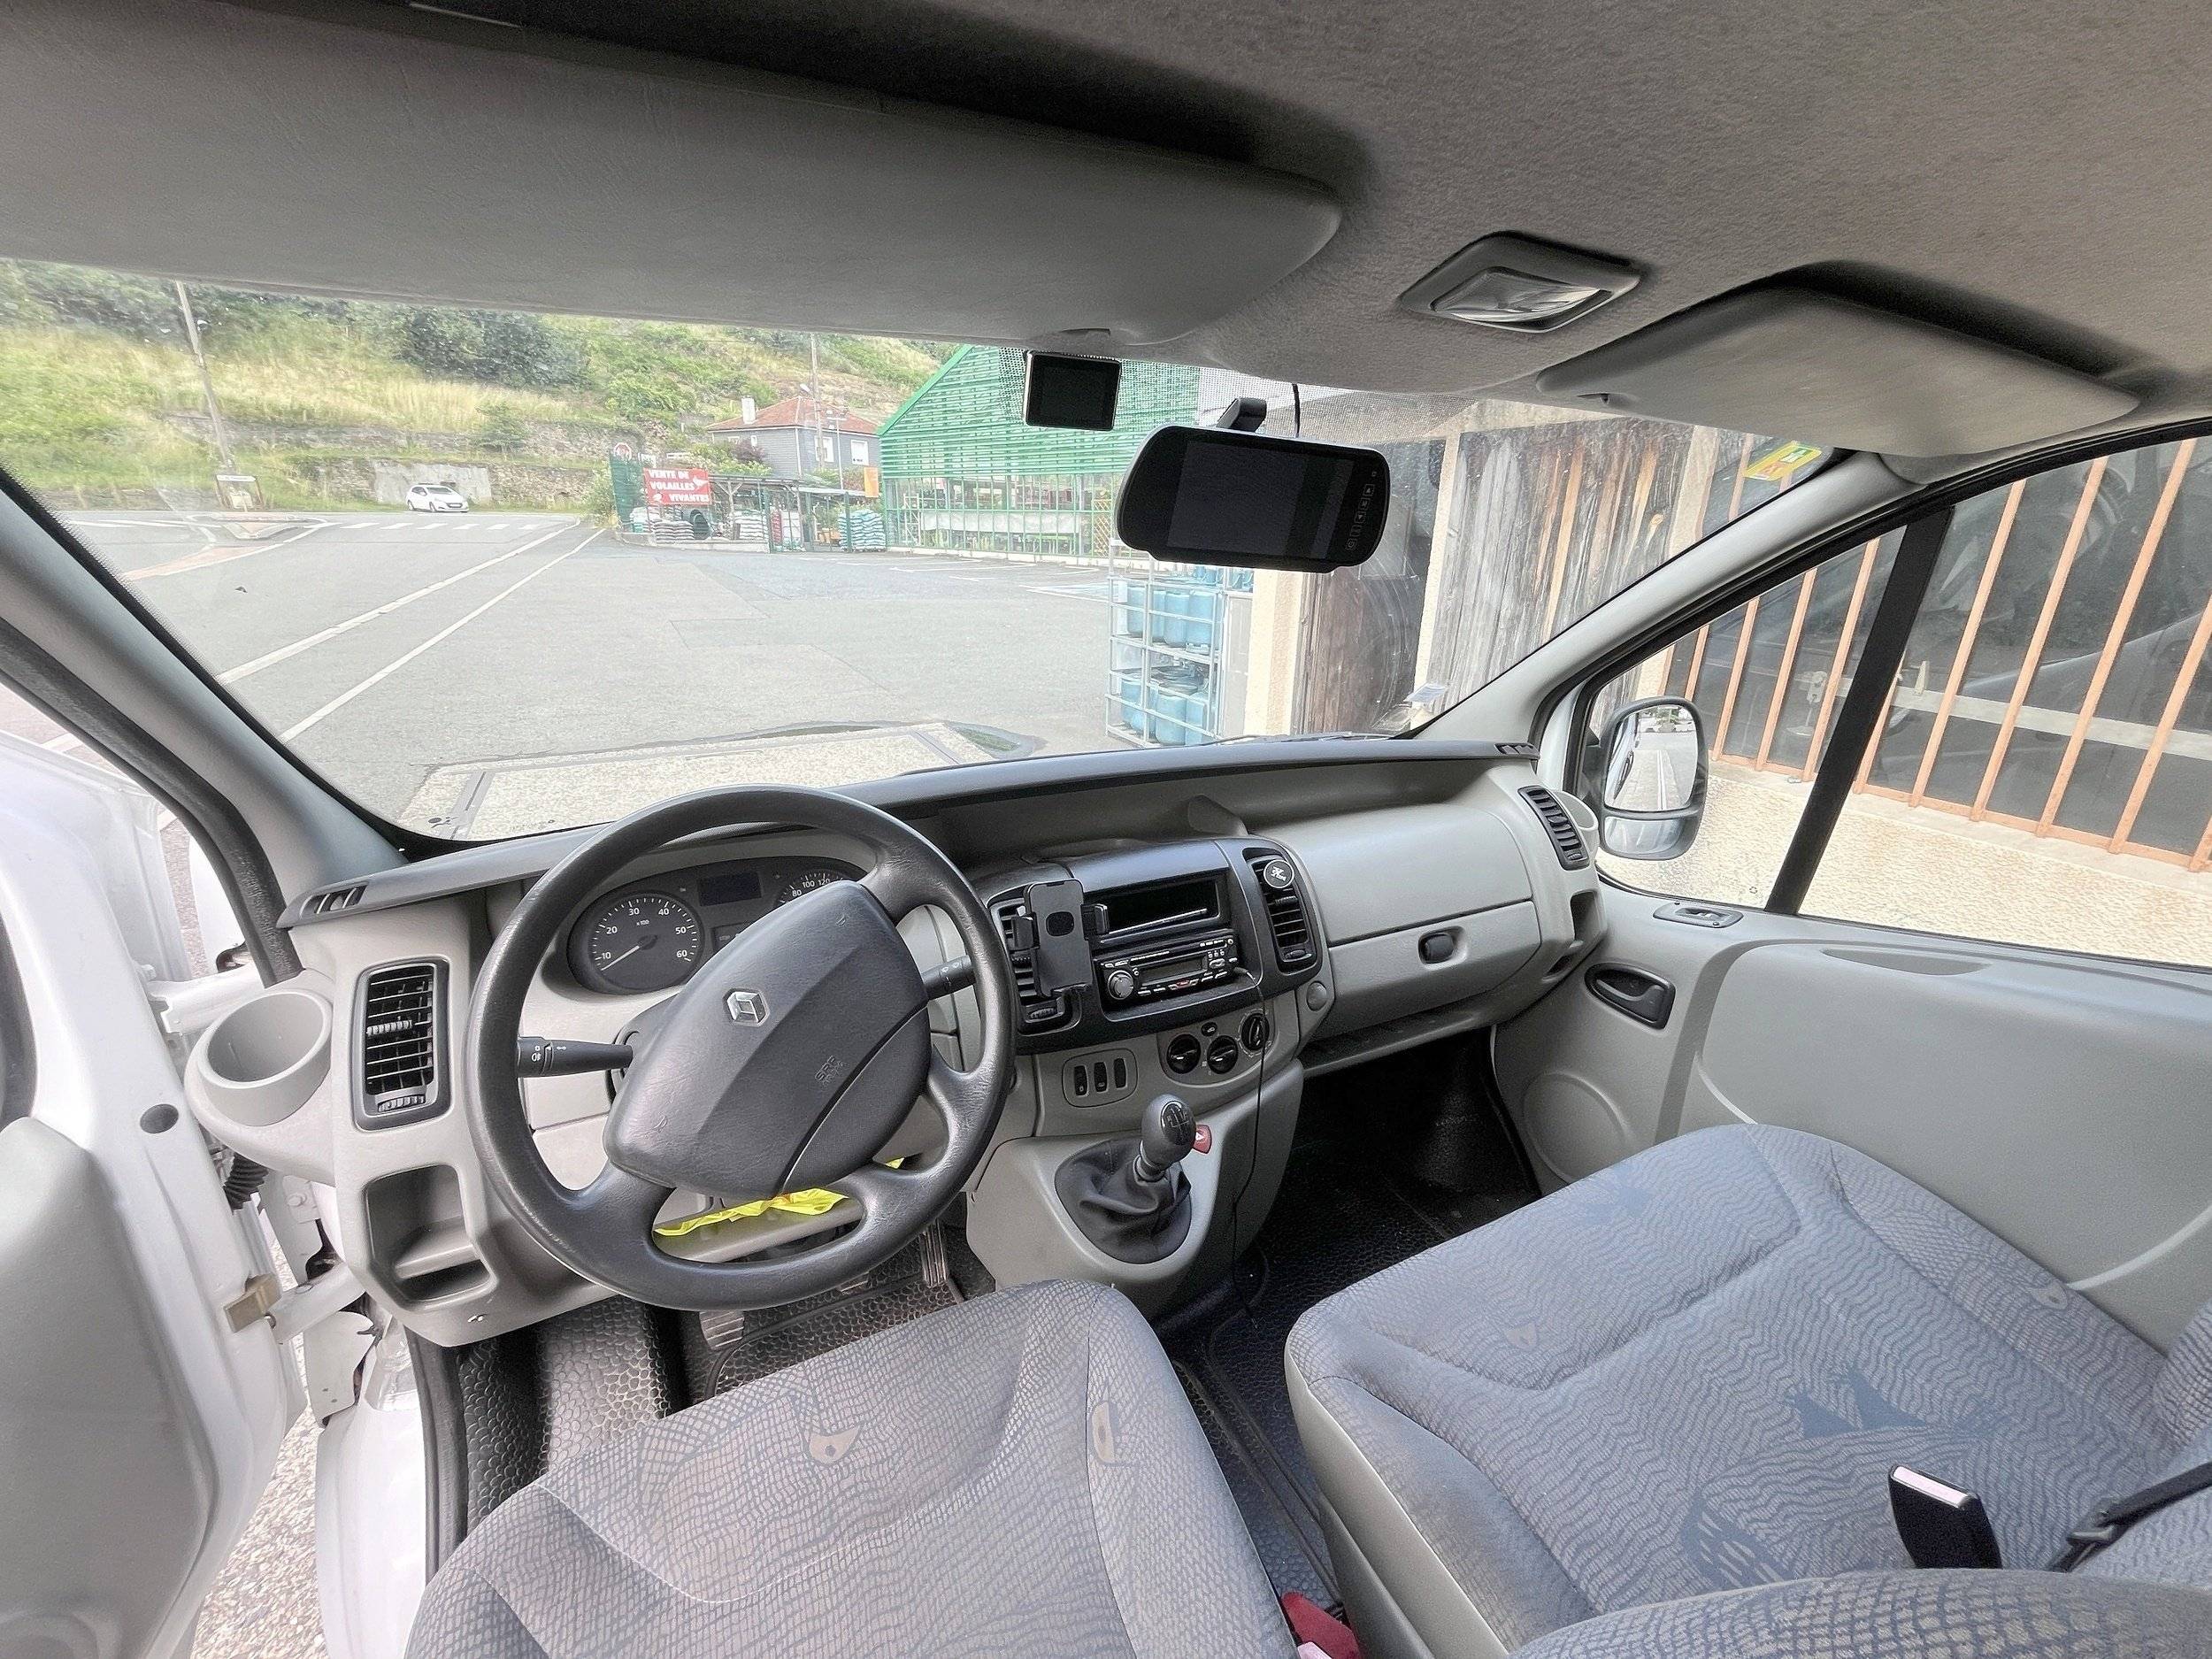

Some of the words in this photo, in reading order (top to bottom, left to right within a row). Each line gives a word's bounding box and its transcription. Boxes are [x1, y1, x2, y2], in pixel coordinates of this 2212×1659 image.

[606, 926, 618, 934] 20
[675, 926, 687, 934] 50
[676, 949, 687, 958] 60
